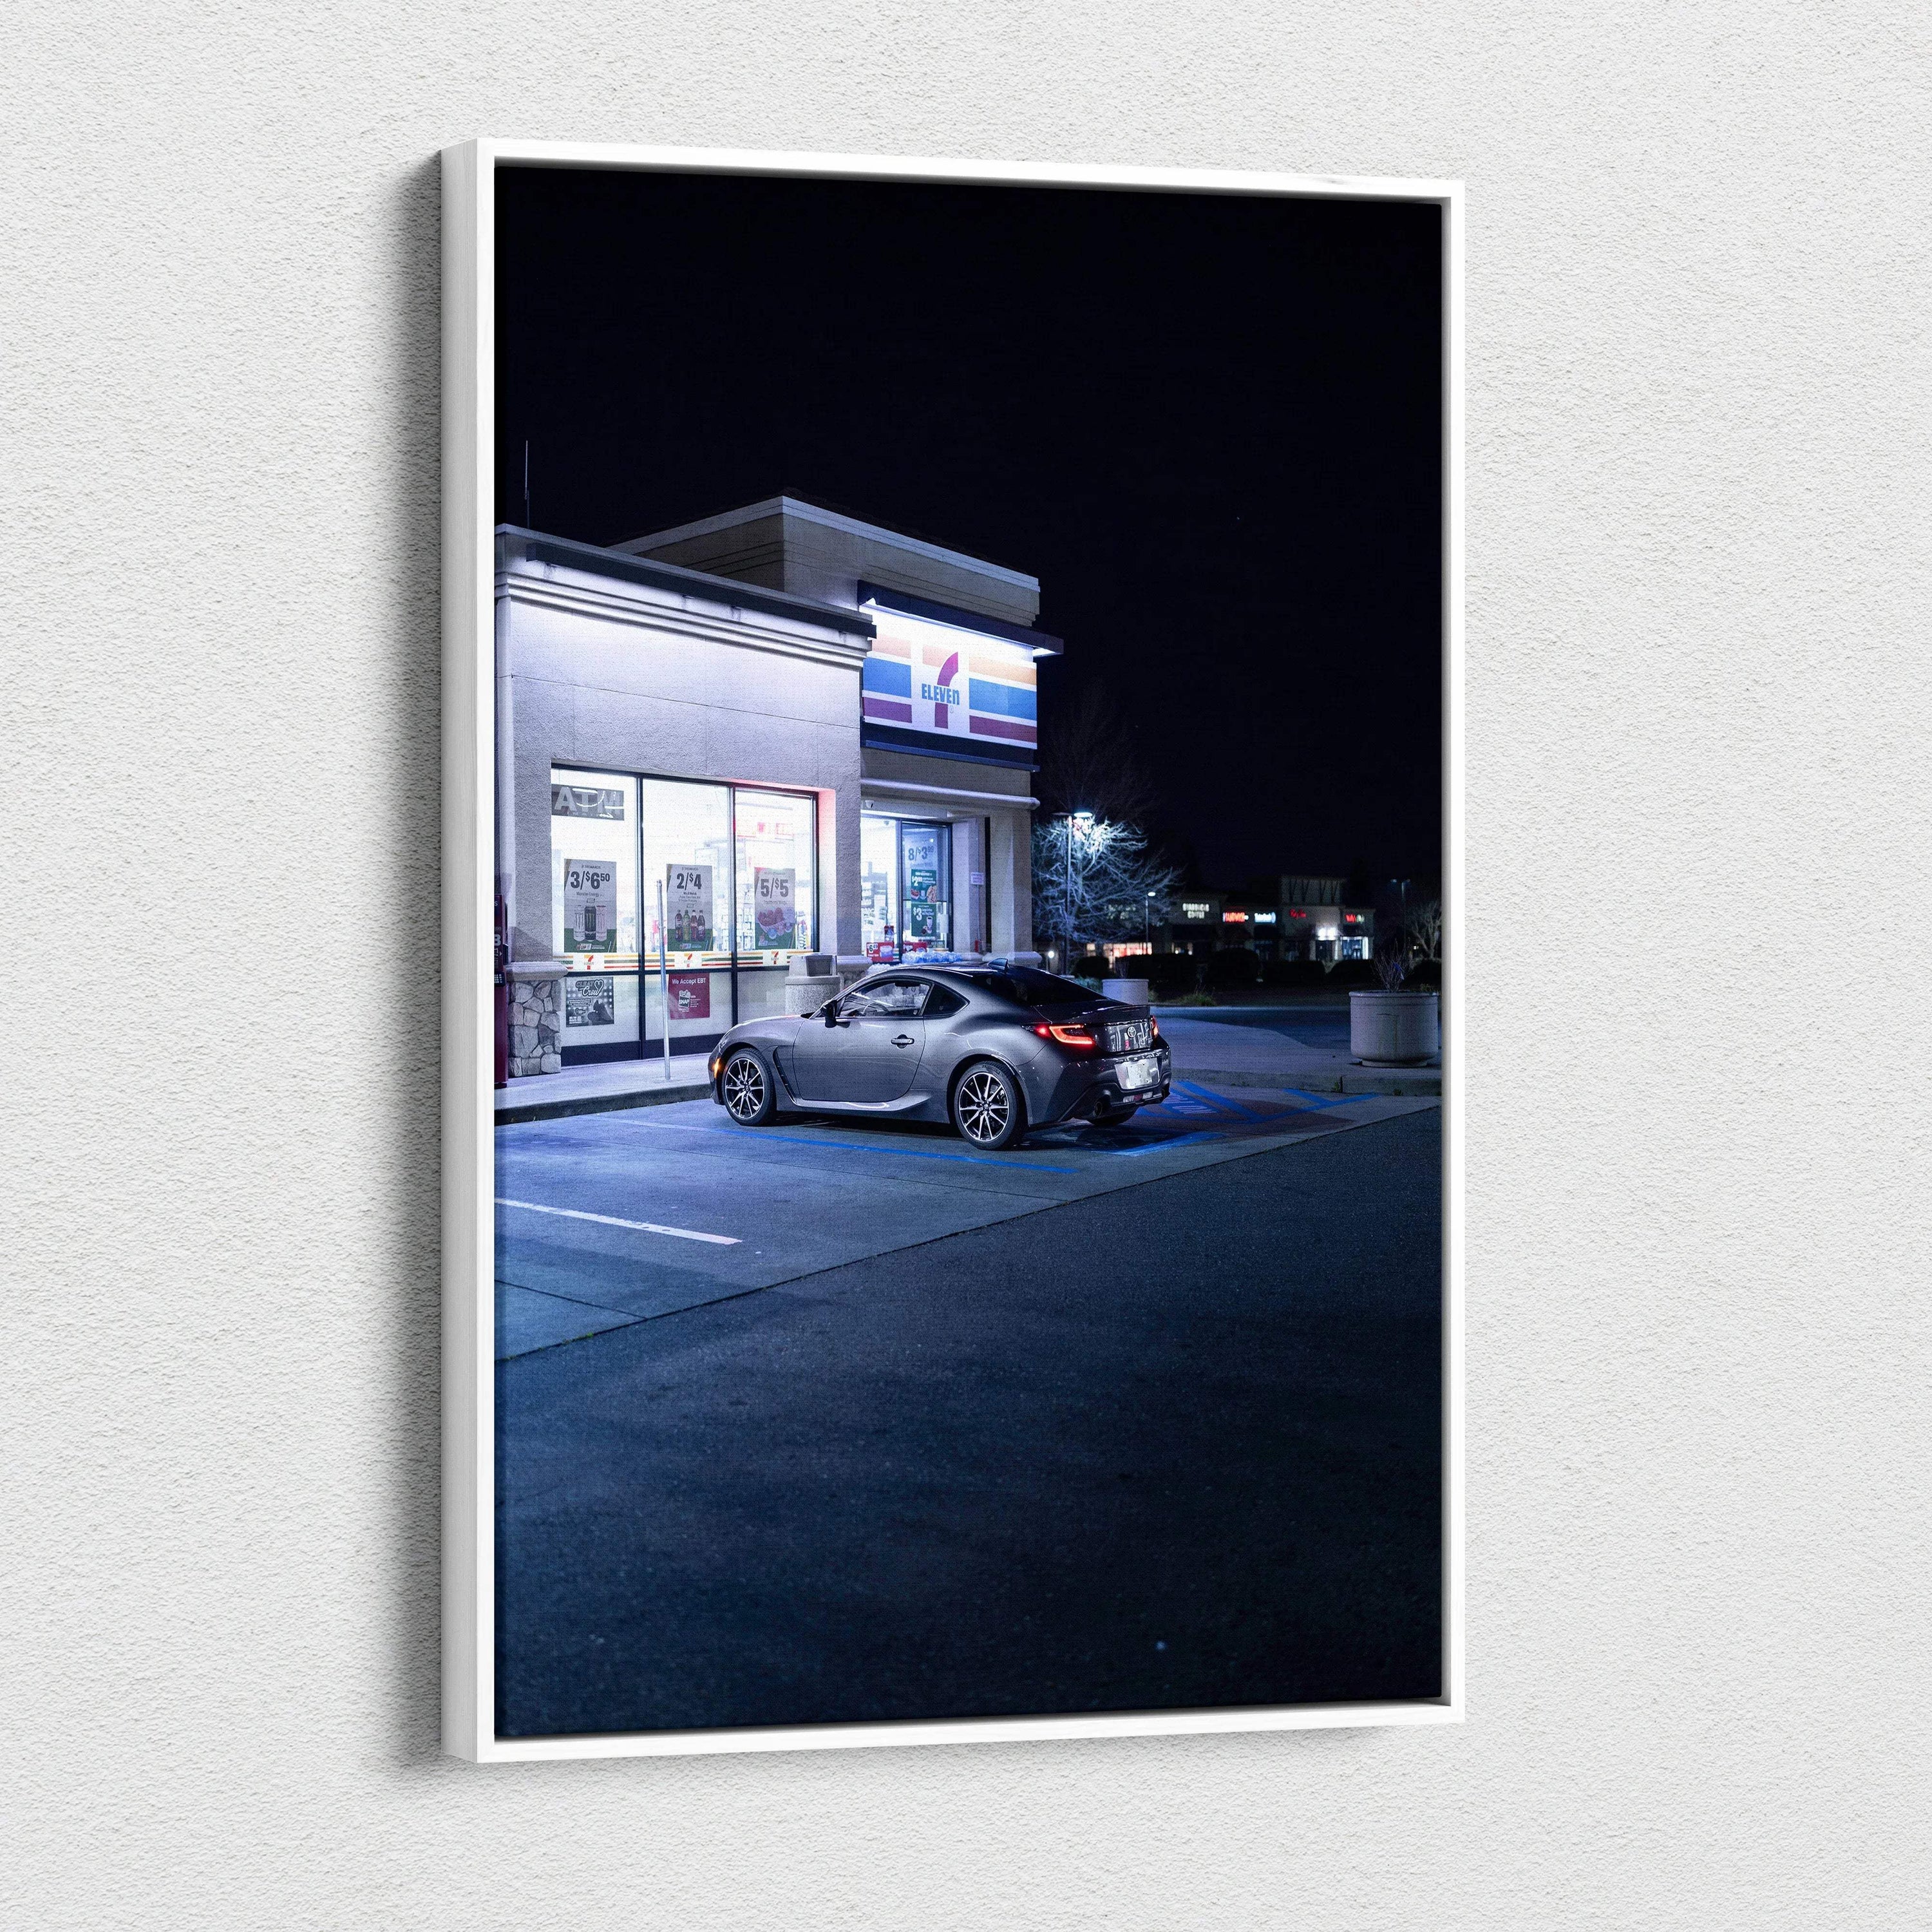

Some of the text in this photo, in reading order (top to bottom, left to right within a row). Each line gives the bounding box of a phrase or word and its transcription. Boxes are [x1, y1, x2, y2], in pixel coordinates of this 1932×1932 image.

[934, 651, 958, 729] 7
[554, 787, 621, 815] ATM
[677, 873, 702, 890] 2/$4
[761, 878, 788, 898] 5/$5
[913, 907, 922, 921] $3
